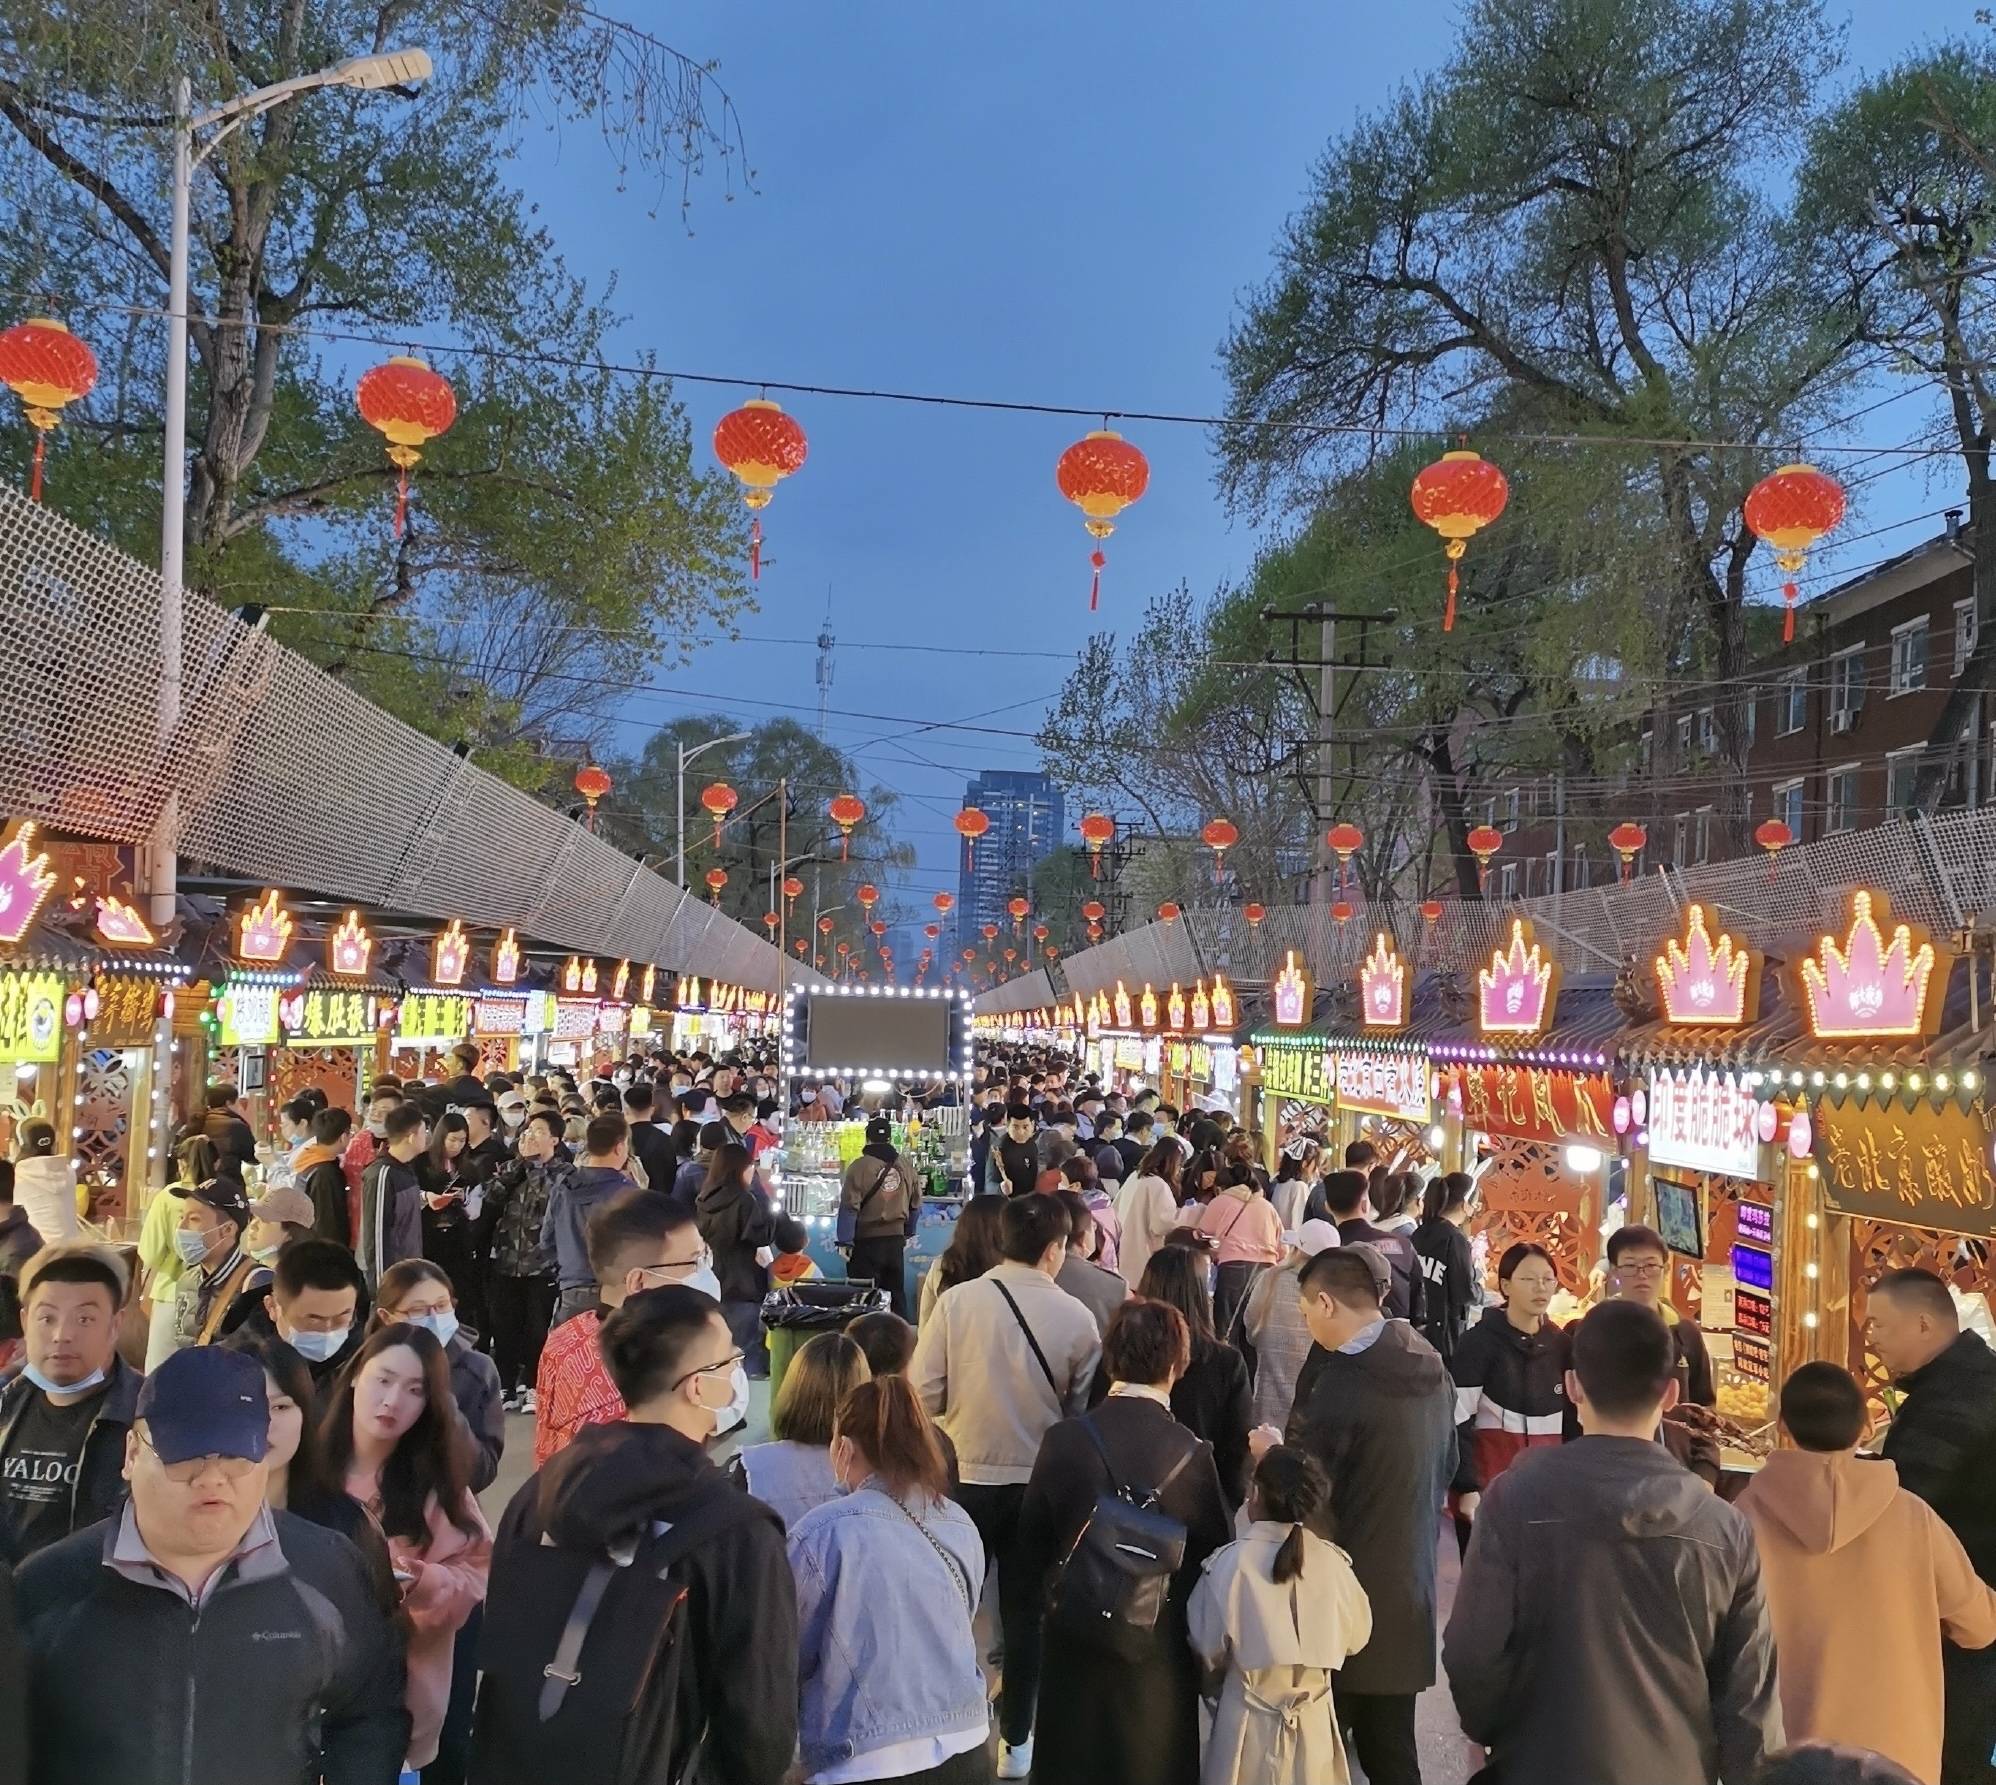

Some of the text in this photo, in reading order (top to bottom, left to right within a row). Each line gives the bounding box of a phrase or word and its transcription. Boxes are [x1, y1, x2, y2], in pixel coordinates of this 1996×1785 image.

[1653, 1079, 1756, 1151] 印度脆脆球
